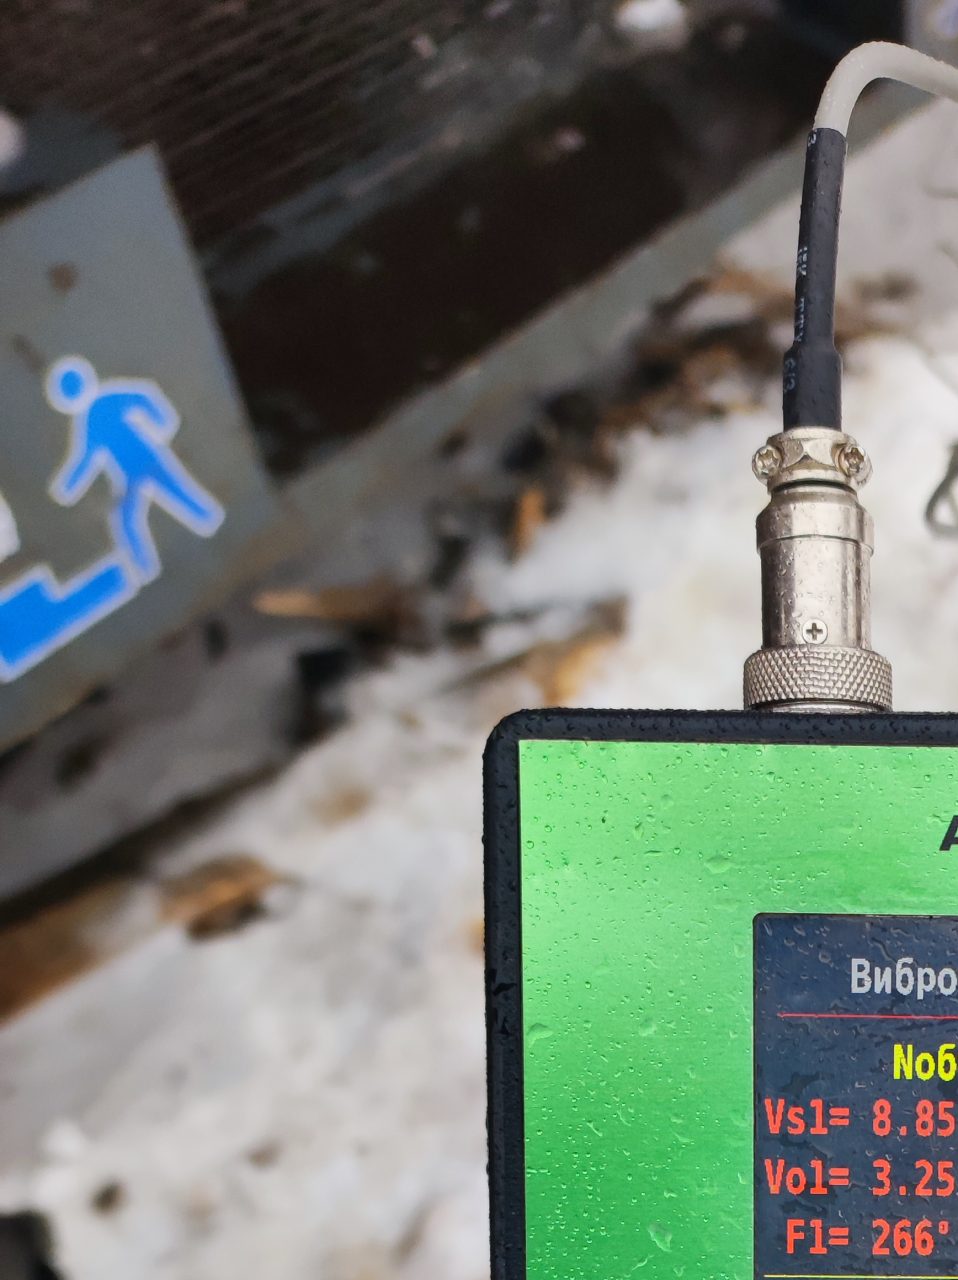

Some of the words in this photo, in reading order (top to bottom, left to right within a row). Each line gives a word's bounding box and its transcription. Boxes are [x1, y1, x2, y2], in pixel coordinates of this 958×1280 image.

[764, 1098, 850, 1135] Vs1=
[872, 1098, 956, 1137] 8.85
[764, 1158, 850, 1195] Vo1=
[872, 1159, 956, 1197] 3.25
[786, 1219, 849, 1255] F1=
[872, 1218, 950, 1256] 266°
